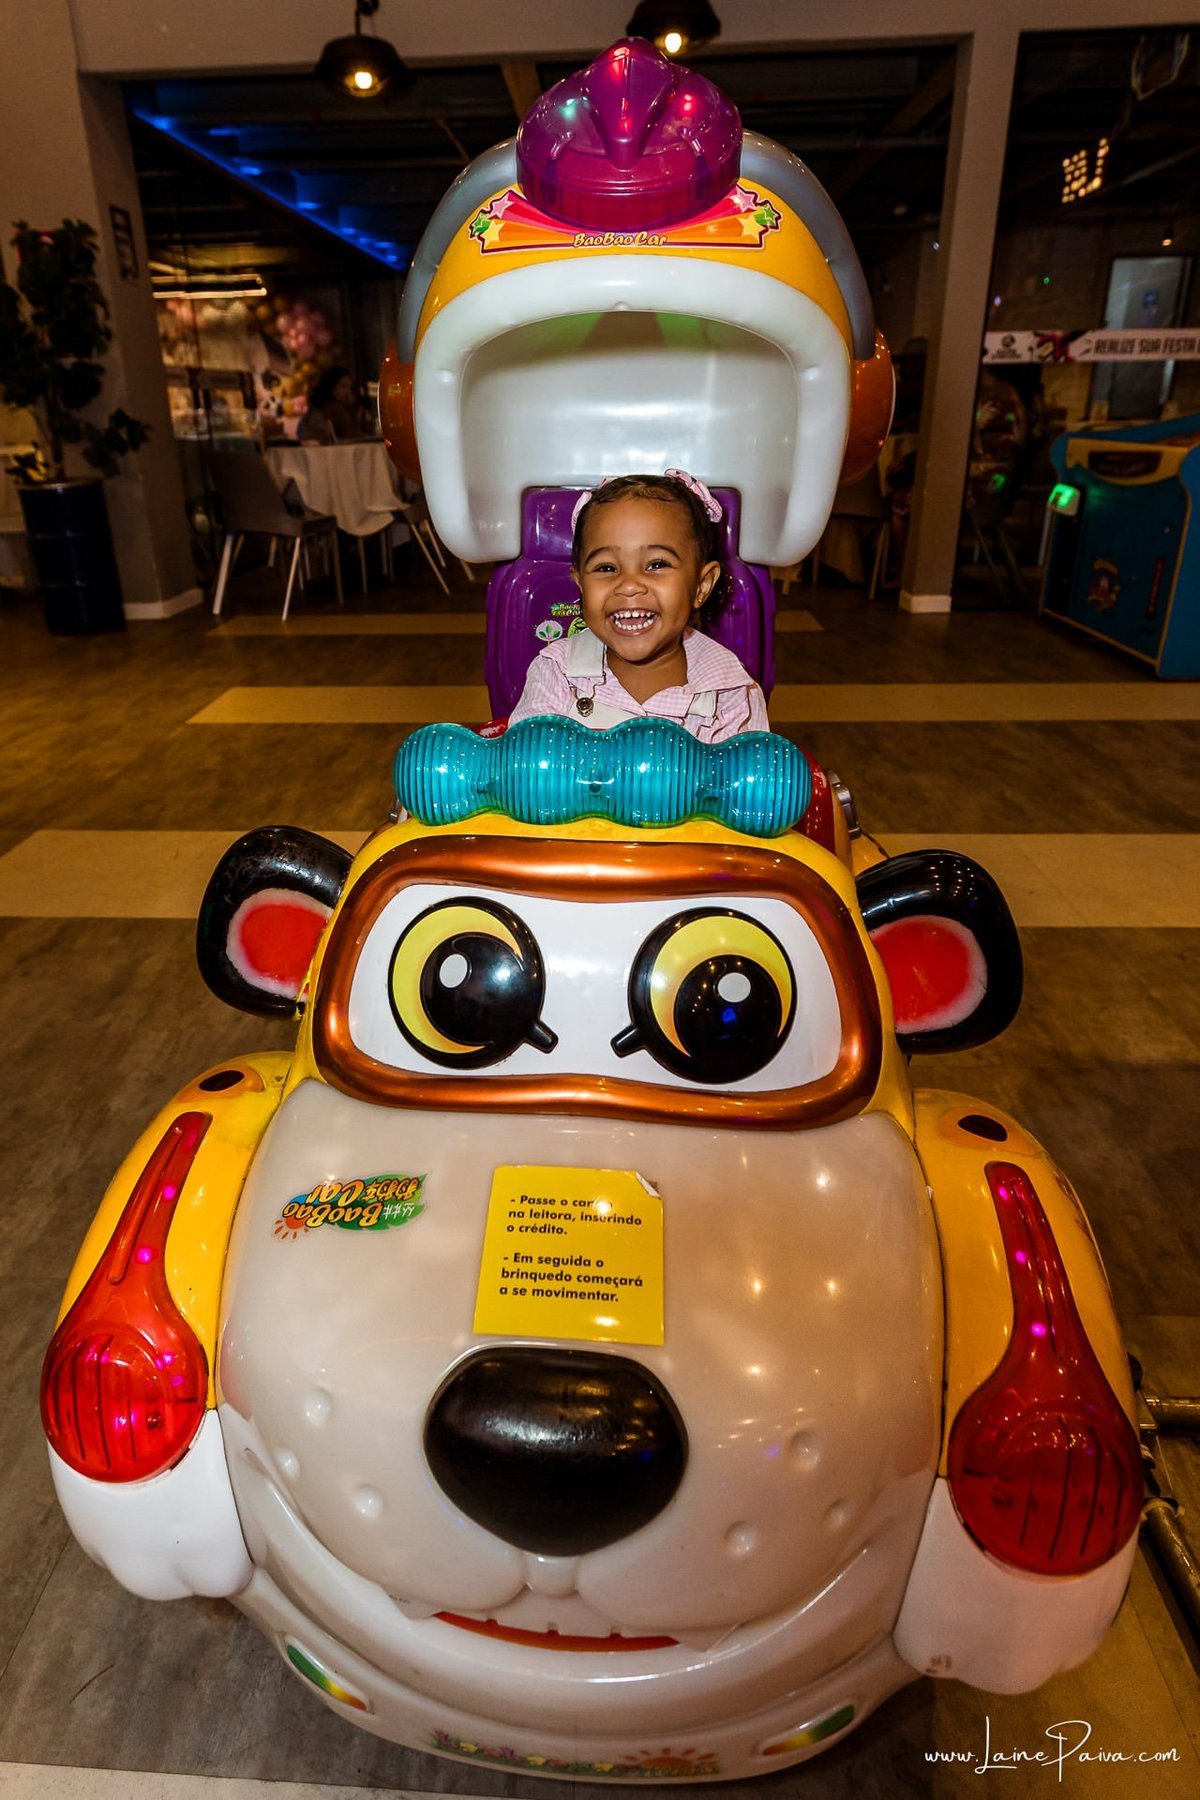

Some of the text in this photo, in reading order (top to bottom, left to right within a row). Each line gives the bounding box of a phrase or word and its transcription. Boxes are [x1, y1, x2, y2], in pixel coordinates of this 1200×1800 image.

[1094, 338, 1136, 354] REALIZE
[1138, 338, 1162, 353] SUA
[1163, 337, 1195, 353] FESTA
[306, 1179, 365, 1207] Car
[520, 1195, 556, 1206] Passe
[560, 1198, 568, 1206] o
[283, 1201, 383, 1228] BaoBao
[508, 1208, 642, 1226] na leitora, inserindo
[506, 1223, 568, 1235] o crédito.
[513, 1252, 533, 1264] Em
[537, 1255, 591, 1268] seguida
[595, 1259, 604, 1268] o
[501, 1267, 643, 1288] brinquedo começará
[499, 1286, 619, 1302] a se movimentar.
